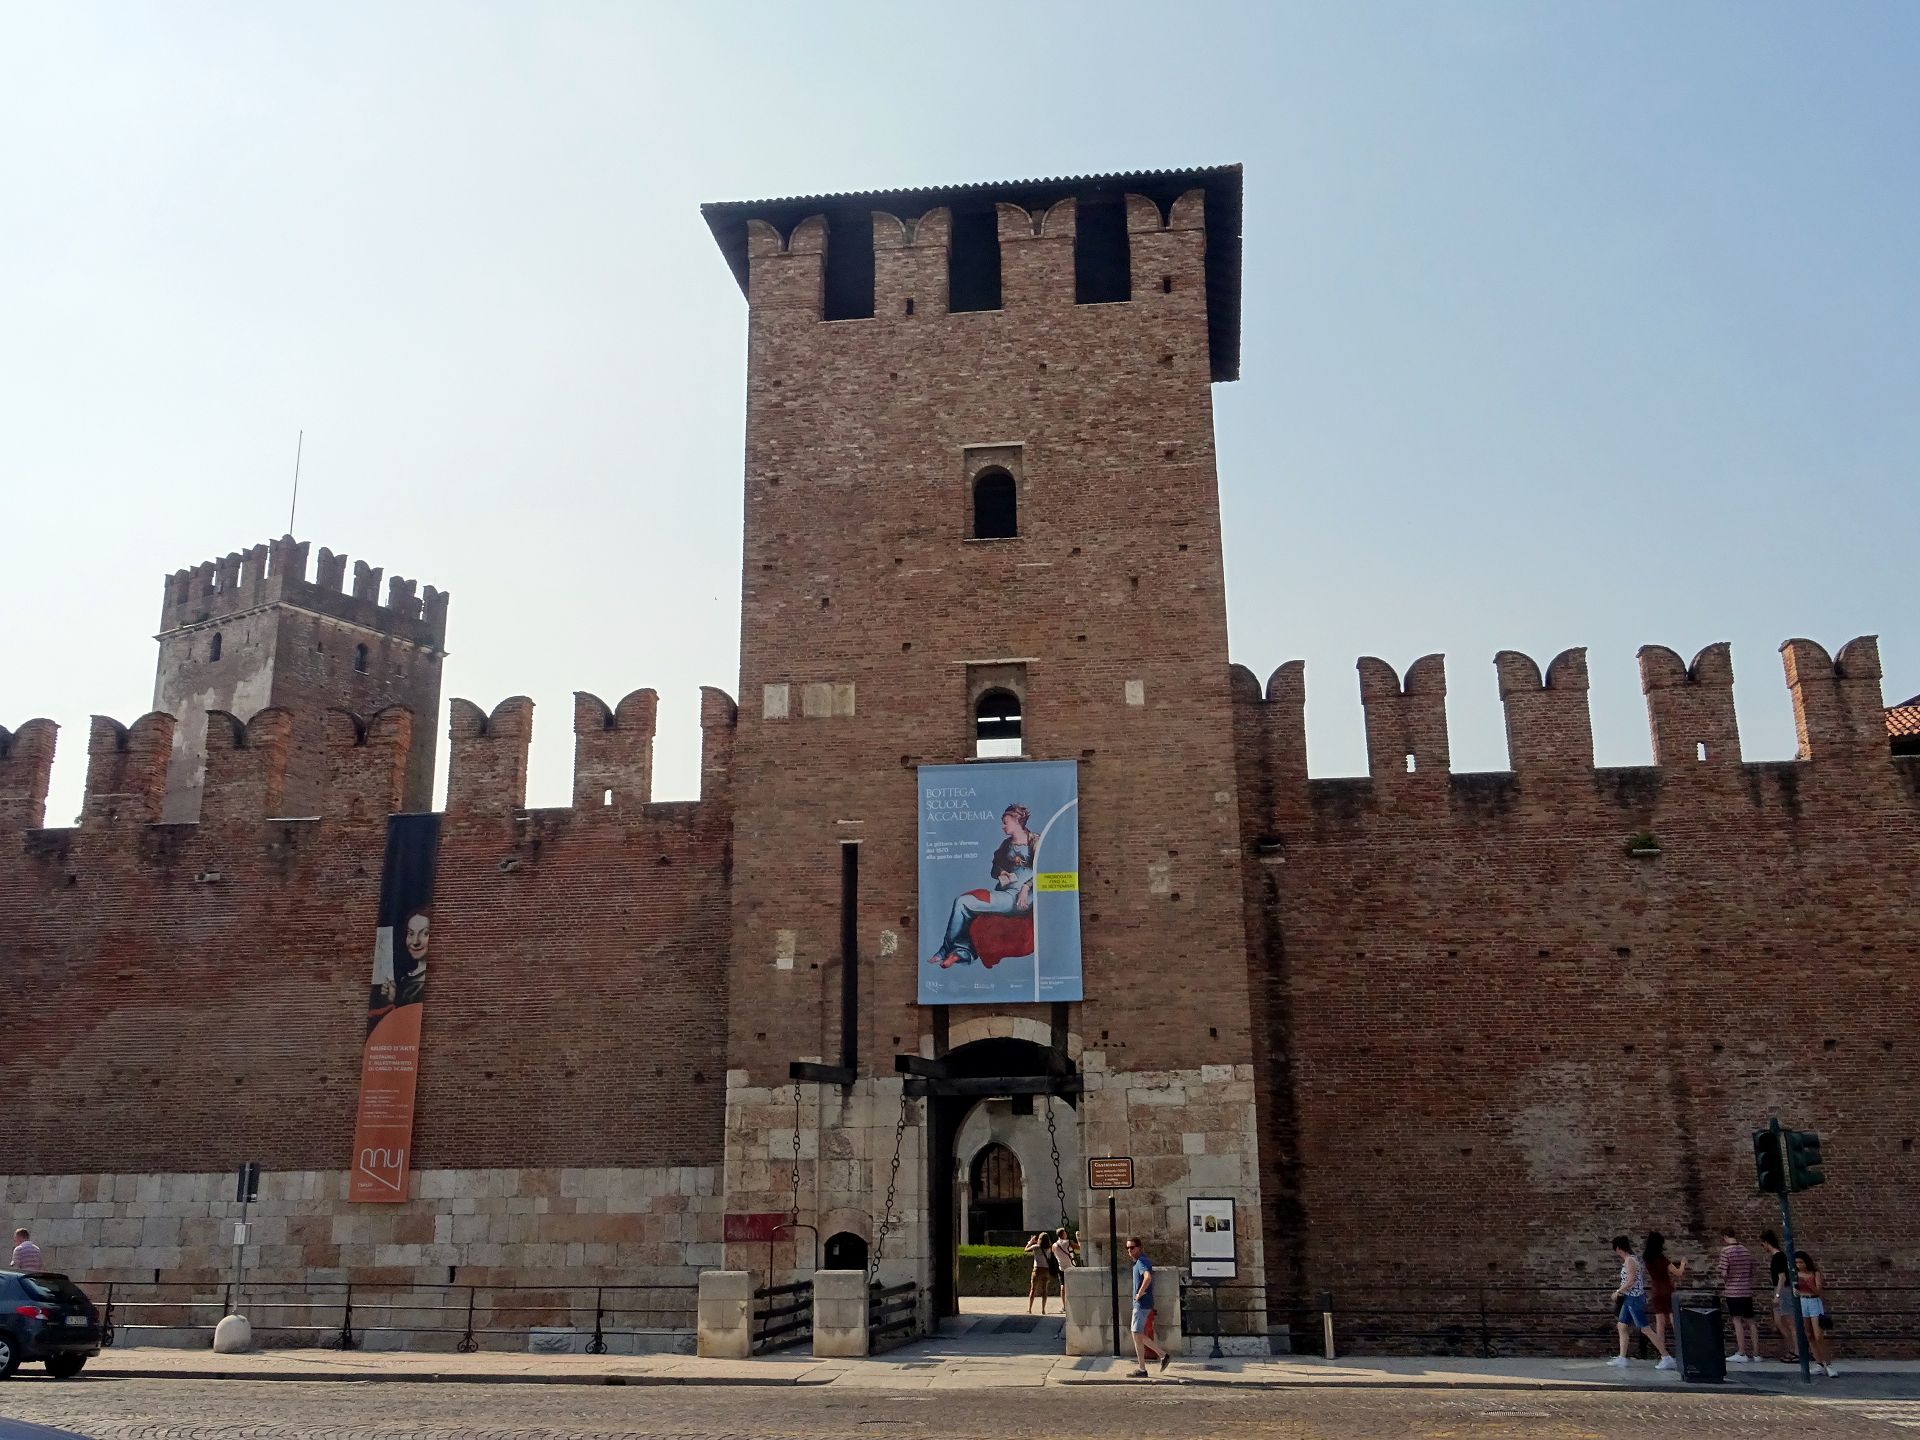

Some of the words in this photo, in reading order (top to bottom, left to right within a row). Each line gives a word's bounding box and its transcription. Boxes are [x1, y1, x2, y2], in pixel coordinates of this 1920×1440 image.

[926, 787, 976, 798] BOTTEGA
[926, 800, 969, 810] SCUOLA
[927, 810, 995, 821] ACCADEMIA
